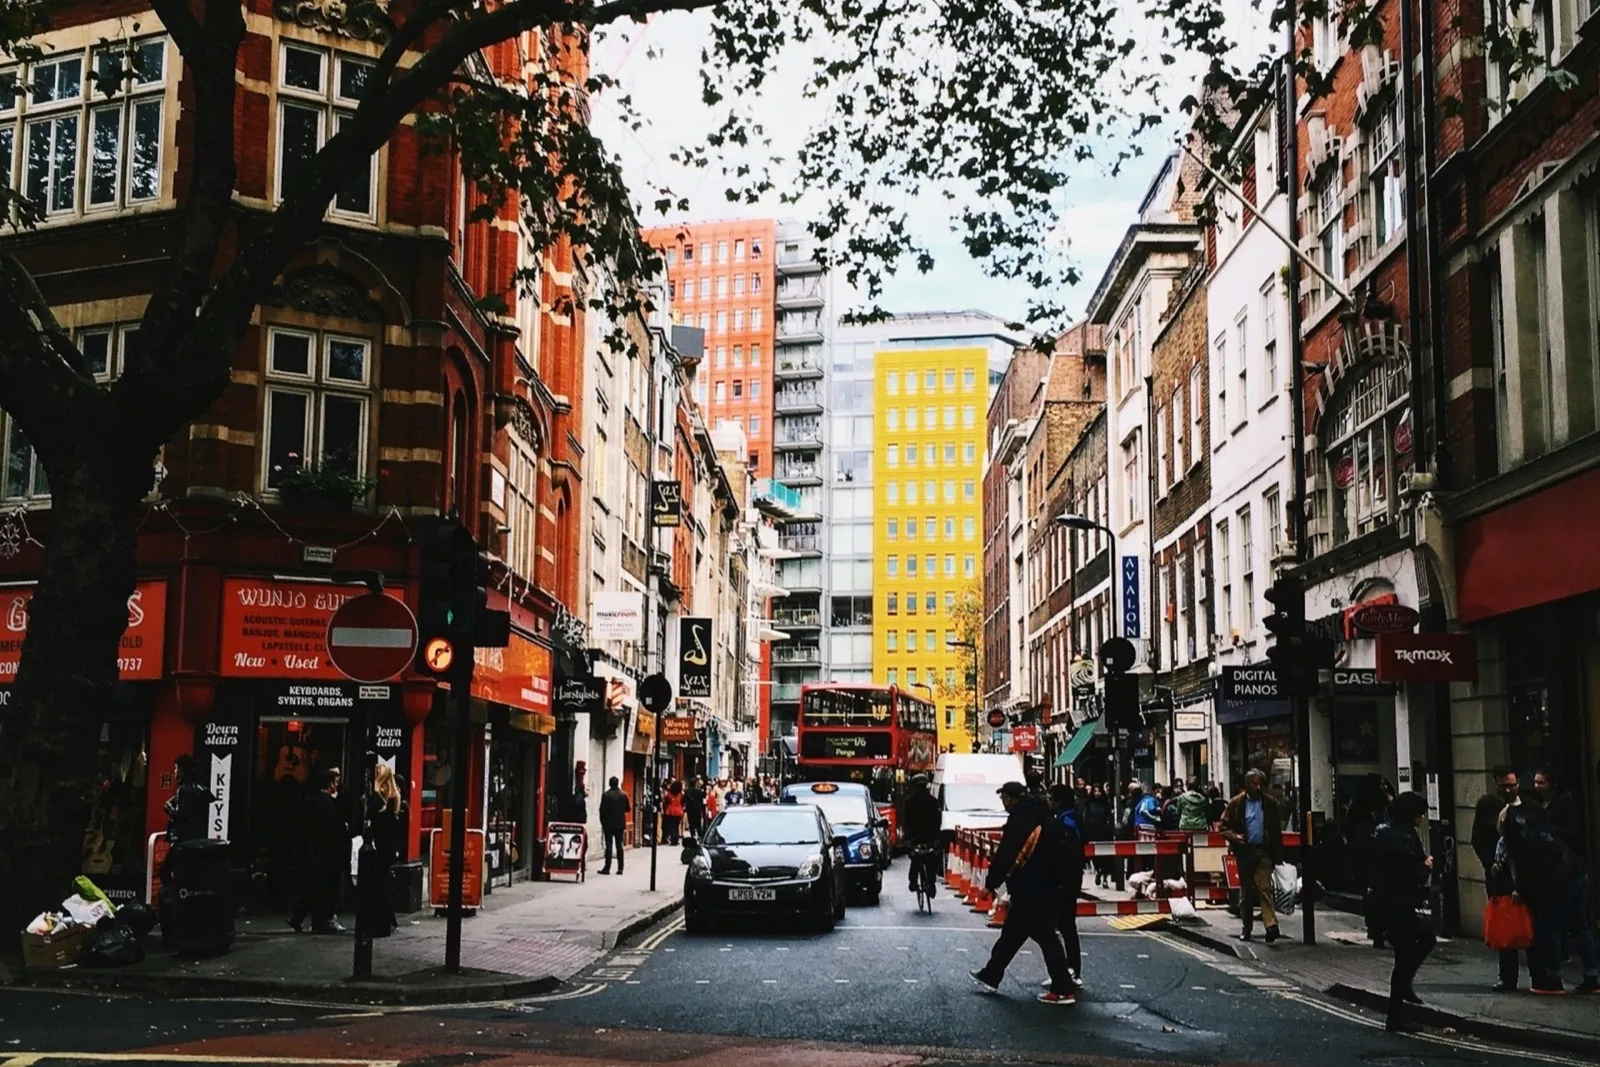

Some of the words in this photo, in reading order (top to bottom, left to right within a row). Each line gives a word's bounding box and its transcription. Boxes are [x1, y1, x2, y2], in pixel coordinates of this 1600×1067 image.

[237, 588, 307, 609] WUNJO
[1125, 558, 1137, 636] AVALON
[243, 615, 287, 625] ACOUSTIC
[597, 610, 637, 618] musicroom
[118, 636, 144, 649] OLD
[233, 652, 266, 667] New
[283, 655, 319, 670] Used
[1233, 670, 1278, 682] DIGITAL
[680, 674, 710, 691] Sax
[289, 685, 343, 697] KEYBOARDS,
[1234, 684, 1278, 696] PIANOS
[278, 697, 315, 707] SYNTHS,
[317, 698, 354, 707] ORGANS
[205, 722, 239, 735] Down
[663, 727, 691, 736] Guitars
[204, 734, 239, 746] stairs
[854, 736, 867, 746] 176
[213, 773, 226, 832] KEYS
